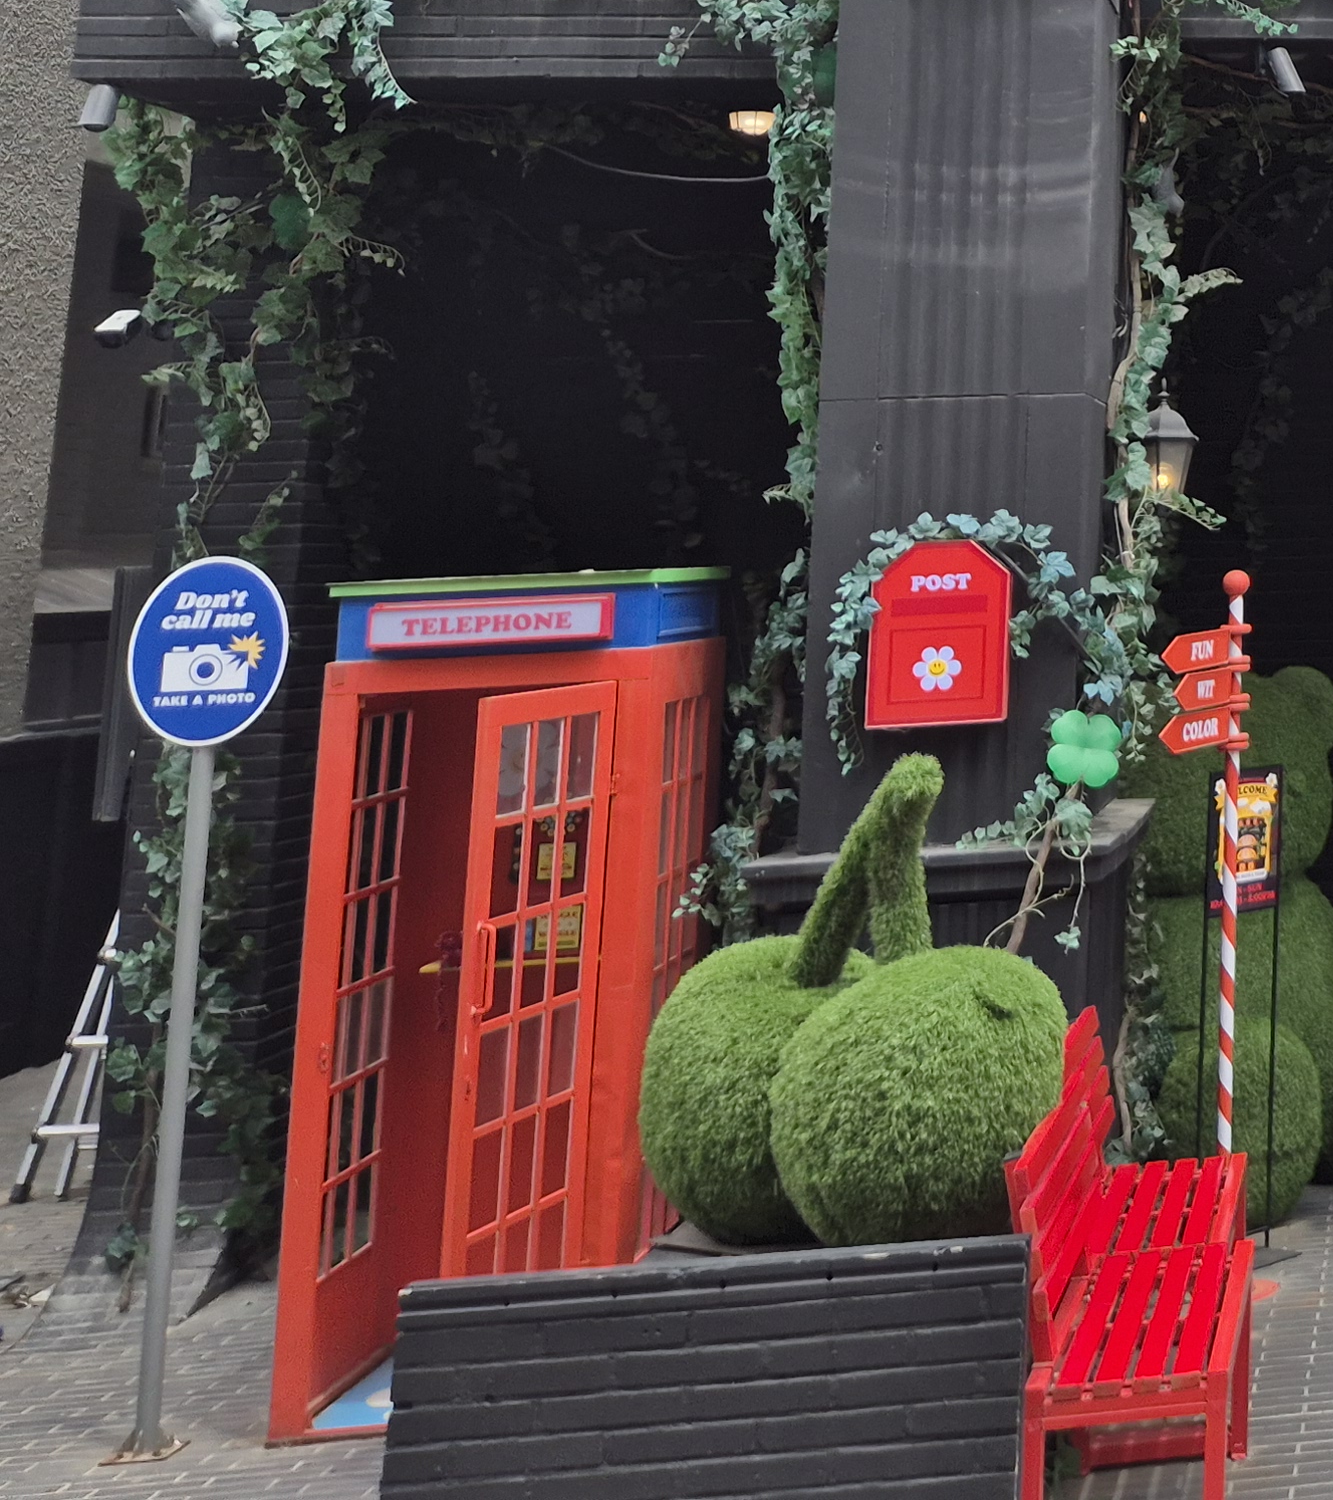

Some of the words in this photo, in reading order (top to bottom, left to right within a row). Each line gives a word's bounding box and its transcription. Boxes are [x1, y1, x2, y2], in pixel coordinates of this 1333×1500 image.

[910, 572, 972, 593] POST
[174, 589, 249, 610] Don't
[161, 610, 213, 630] call
[212, 611, 256, 629] me
[401, 610, 573, 637] TELEPHONE
[1190, 639, 1214, 662] FUN
[153, 696, 188, 707] TAKE
[192, 694, 203, 706] A
[207, 692, 256, 706] PHOTO
[1197, 679, 1216, 699] WIT
[1182, 717, 1219, 742] COLOR
